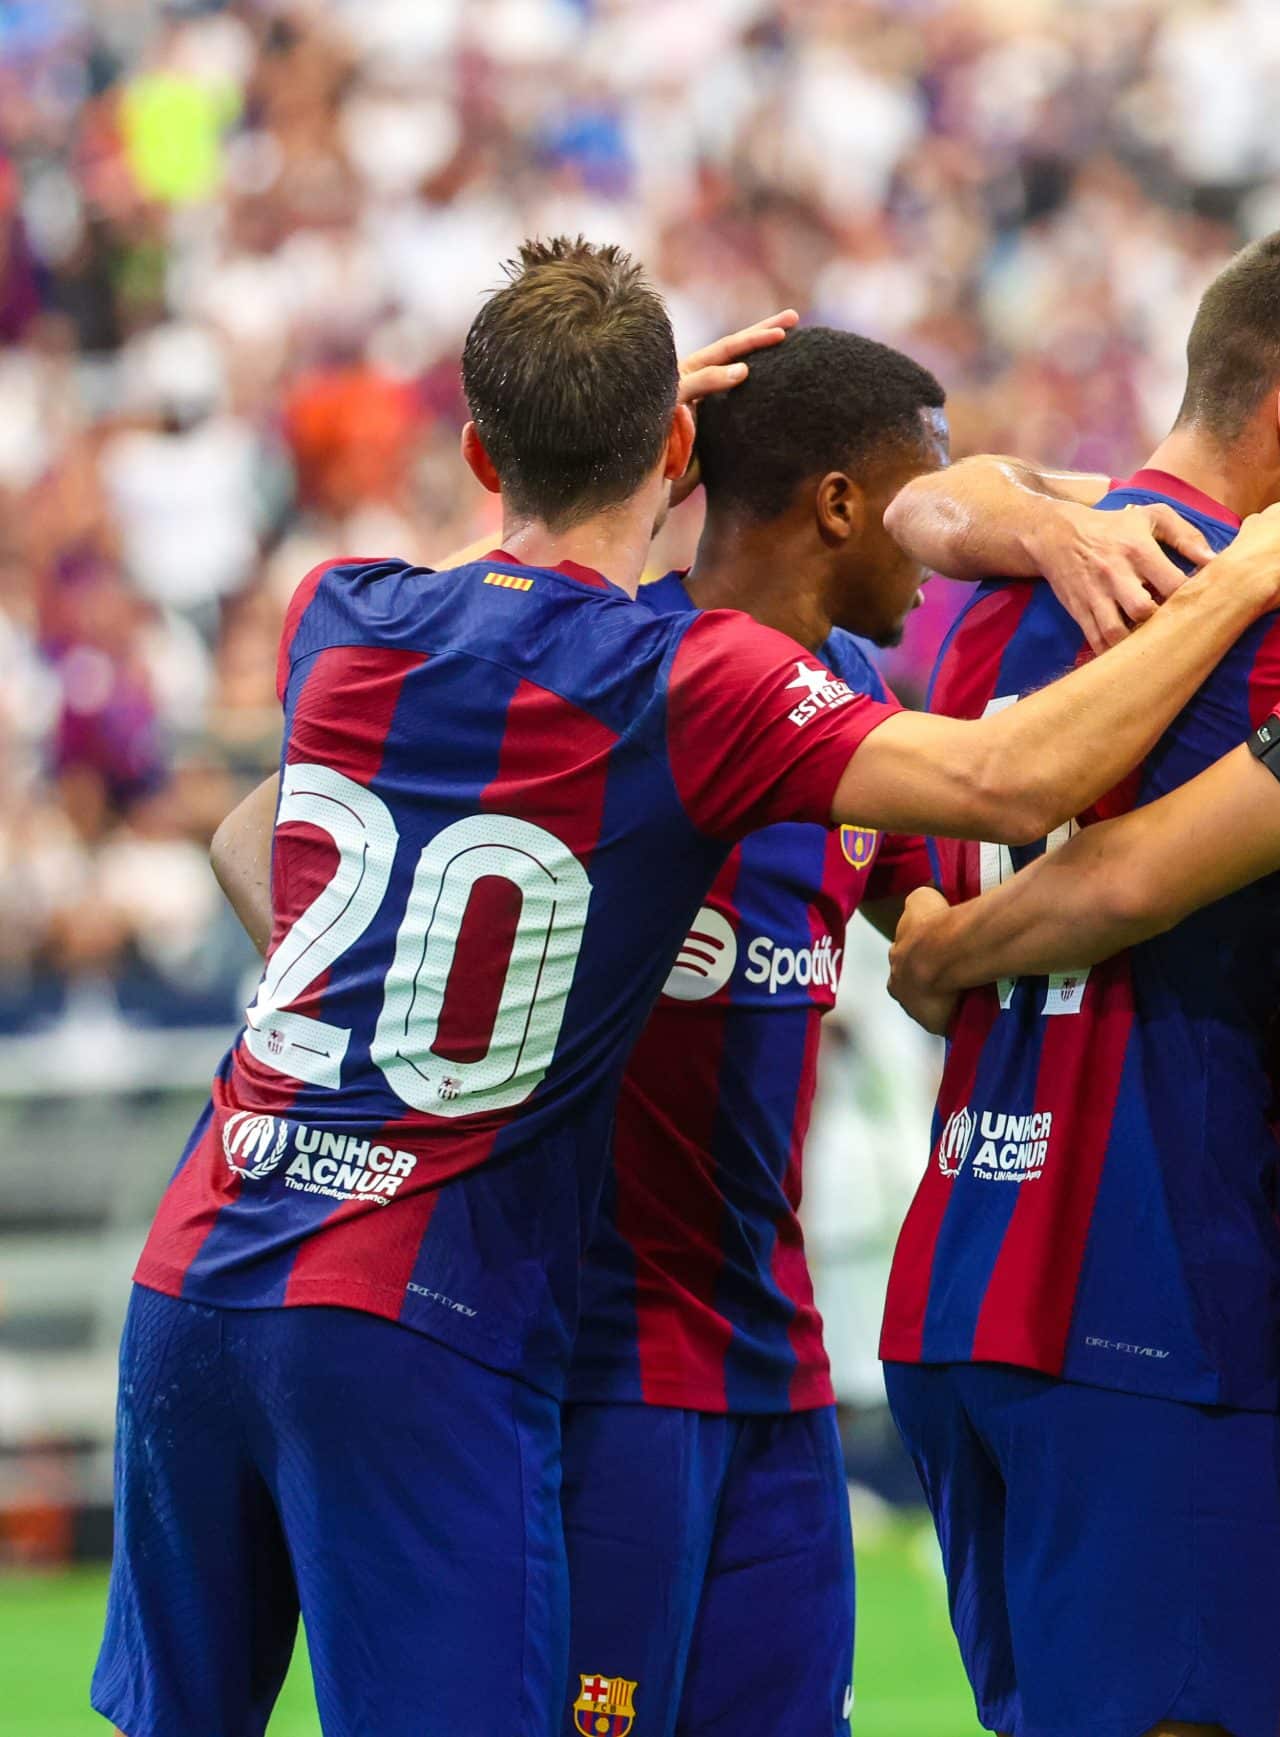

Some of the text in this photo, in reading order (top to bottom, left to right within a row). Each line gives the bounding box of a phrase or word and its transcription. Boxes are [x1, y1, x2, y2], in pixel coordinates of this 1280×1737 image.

[243, 763, 593, 1118] 20
[745, 935, 842, 994] Spotify
[285, 1152, 404, 1196] ACNUR
[294, 1124, 418, 1177] UNHCR
[972, 1167, 993, 1180] The
[284, 1176, 304, 1191] The
